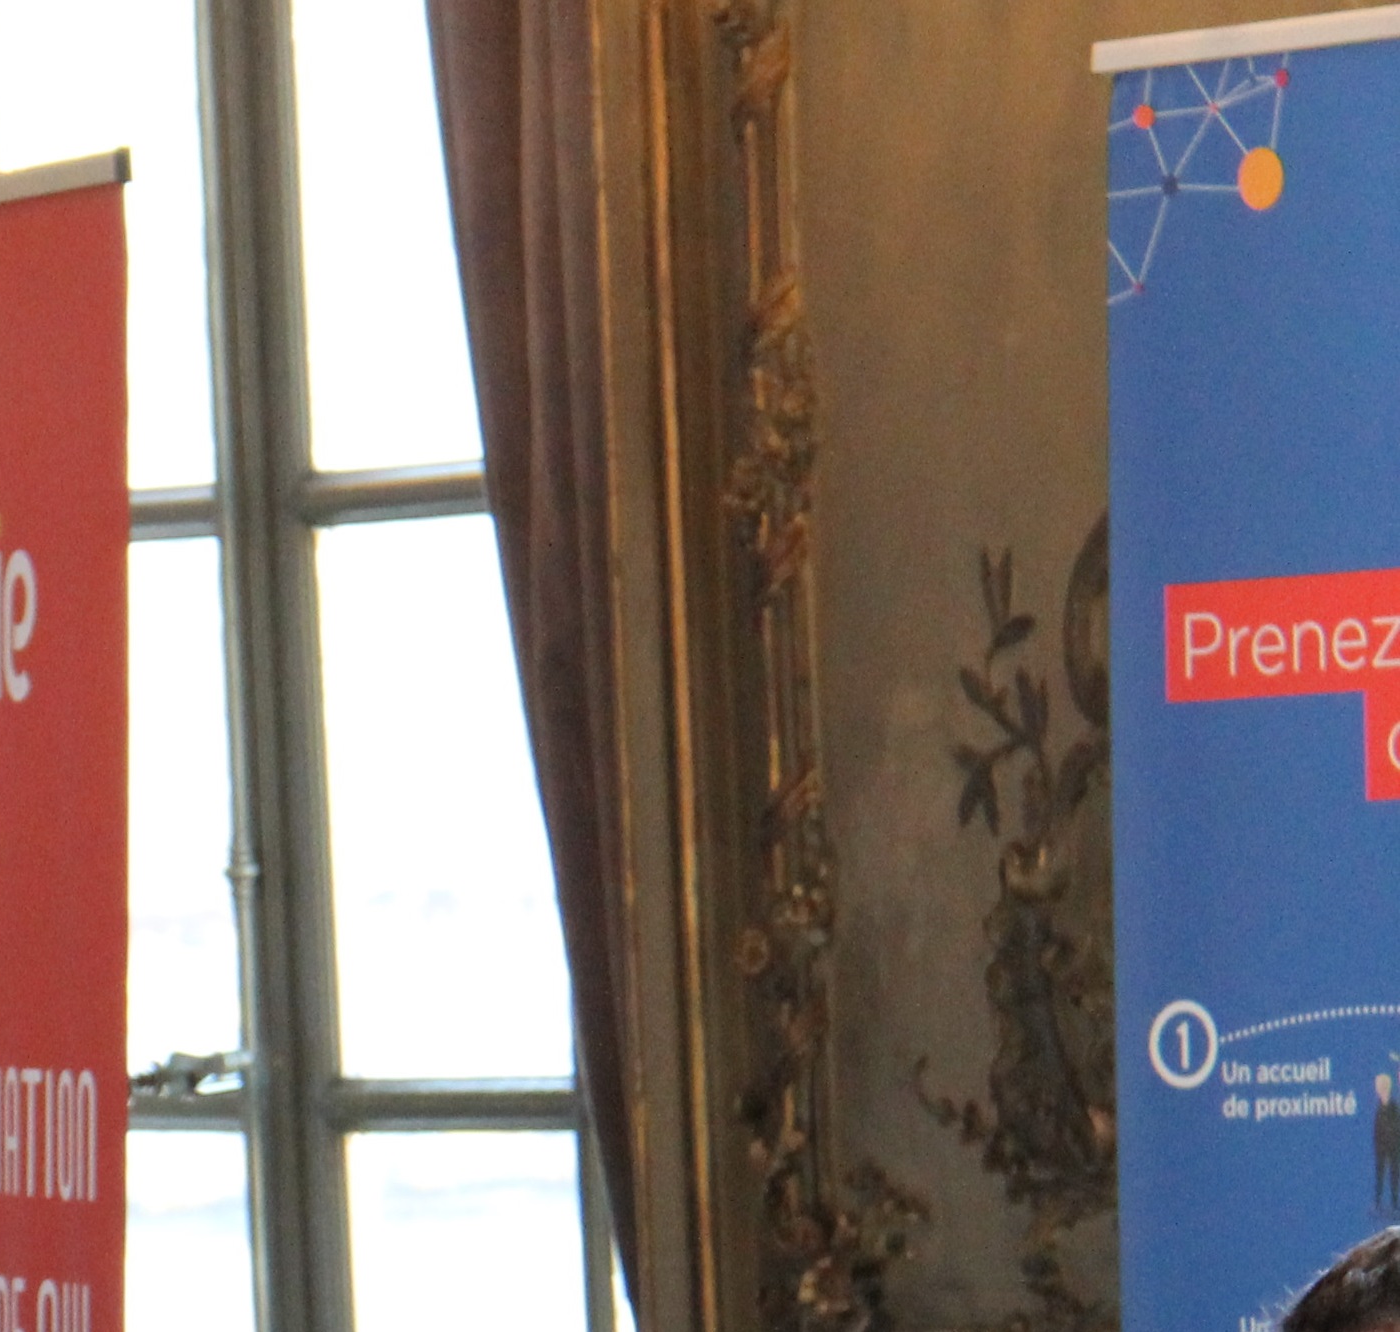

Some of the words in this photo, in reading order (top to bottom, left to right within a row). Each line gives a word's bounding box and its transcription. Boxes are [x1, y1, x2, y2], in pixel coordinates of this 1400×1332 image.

[1182, 610, 1400, 679] Prenez
[1222, 1060, 1250, 1084] Un
[1256, 1057, 1331, 1084] accueil
[1223, 1095, 1248, 1118] de
[1255, 1091, 1357, 1121] proximité
